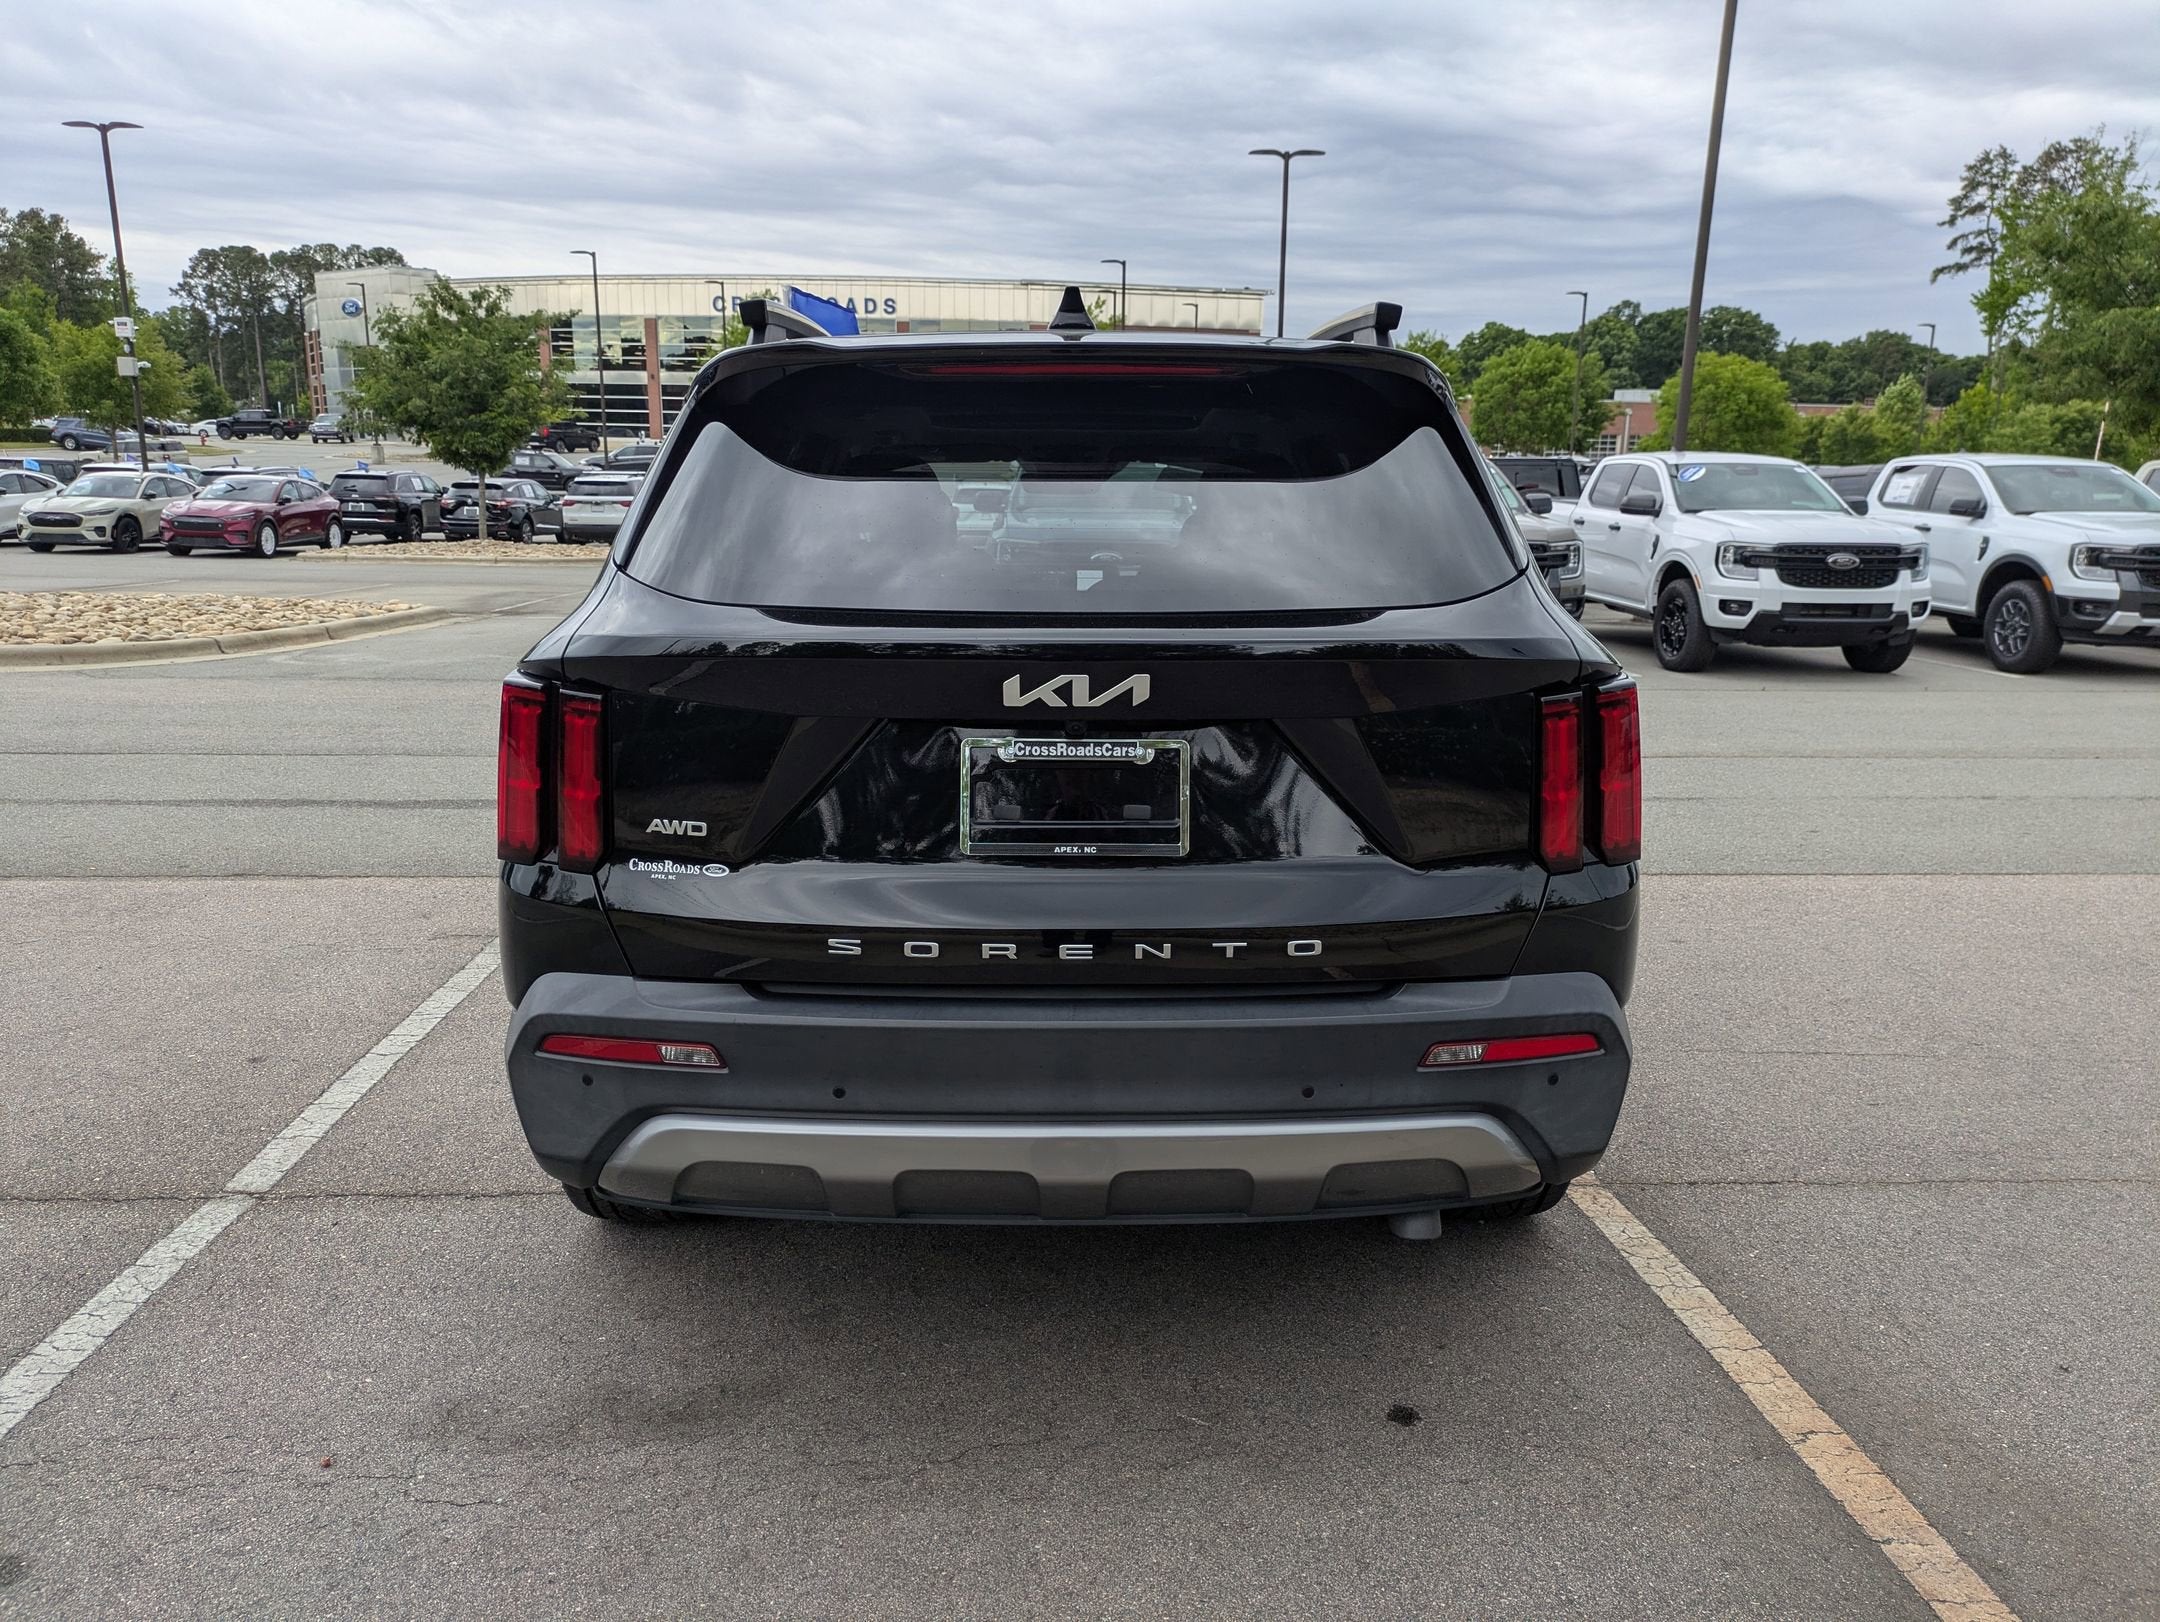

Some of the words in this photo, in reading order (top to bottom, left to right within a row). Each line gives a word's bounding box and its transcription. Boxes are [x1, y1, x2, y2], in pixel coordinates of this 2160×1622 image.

[1014, 742, 1136, 757] CrossRoadsCars
[645, 818, 708, 837] AWD
[1053, 846, 1082, 854] APEX,
[1084, 846, 1097, 854] NC
[826, 938, 1323, 961] SORENTO
